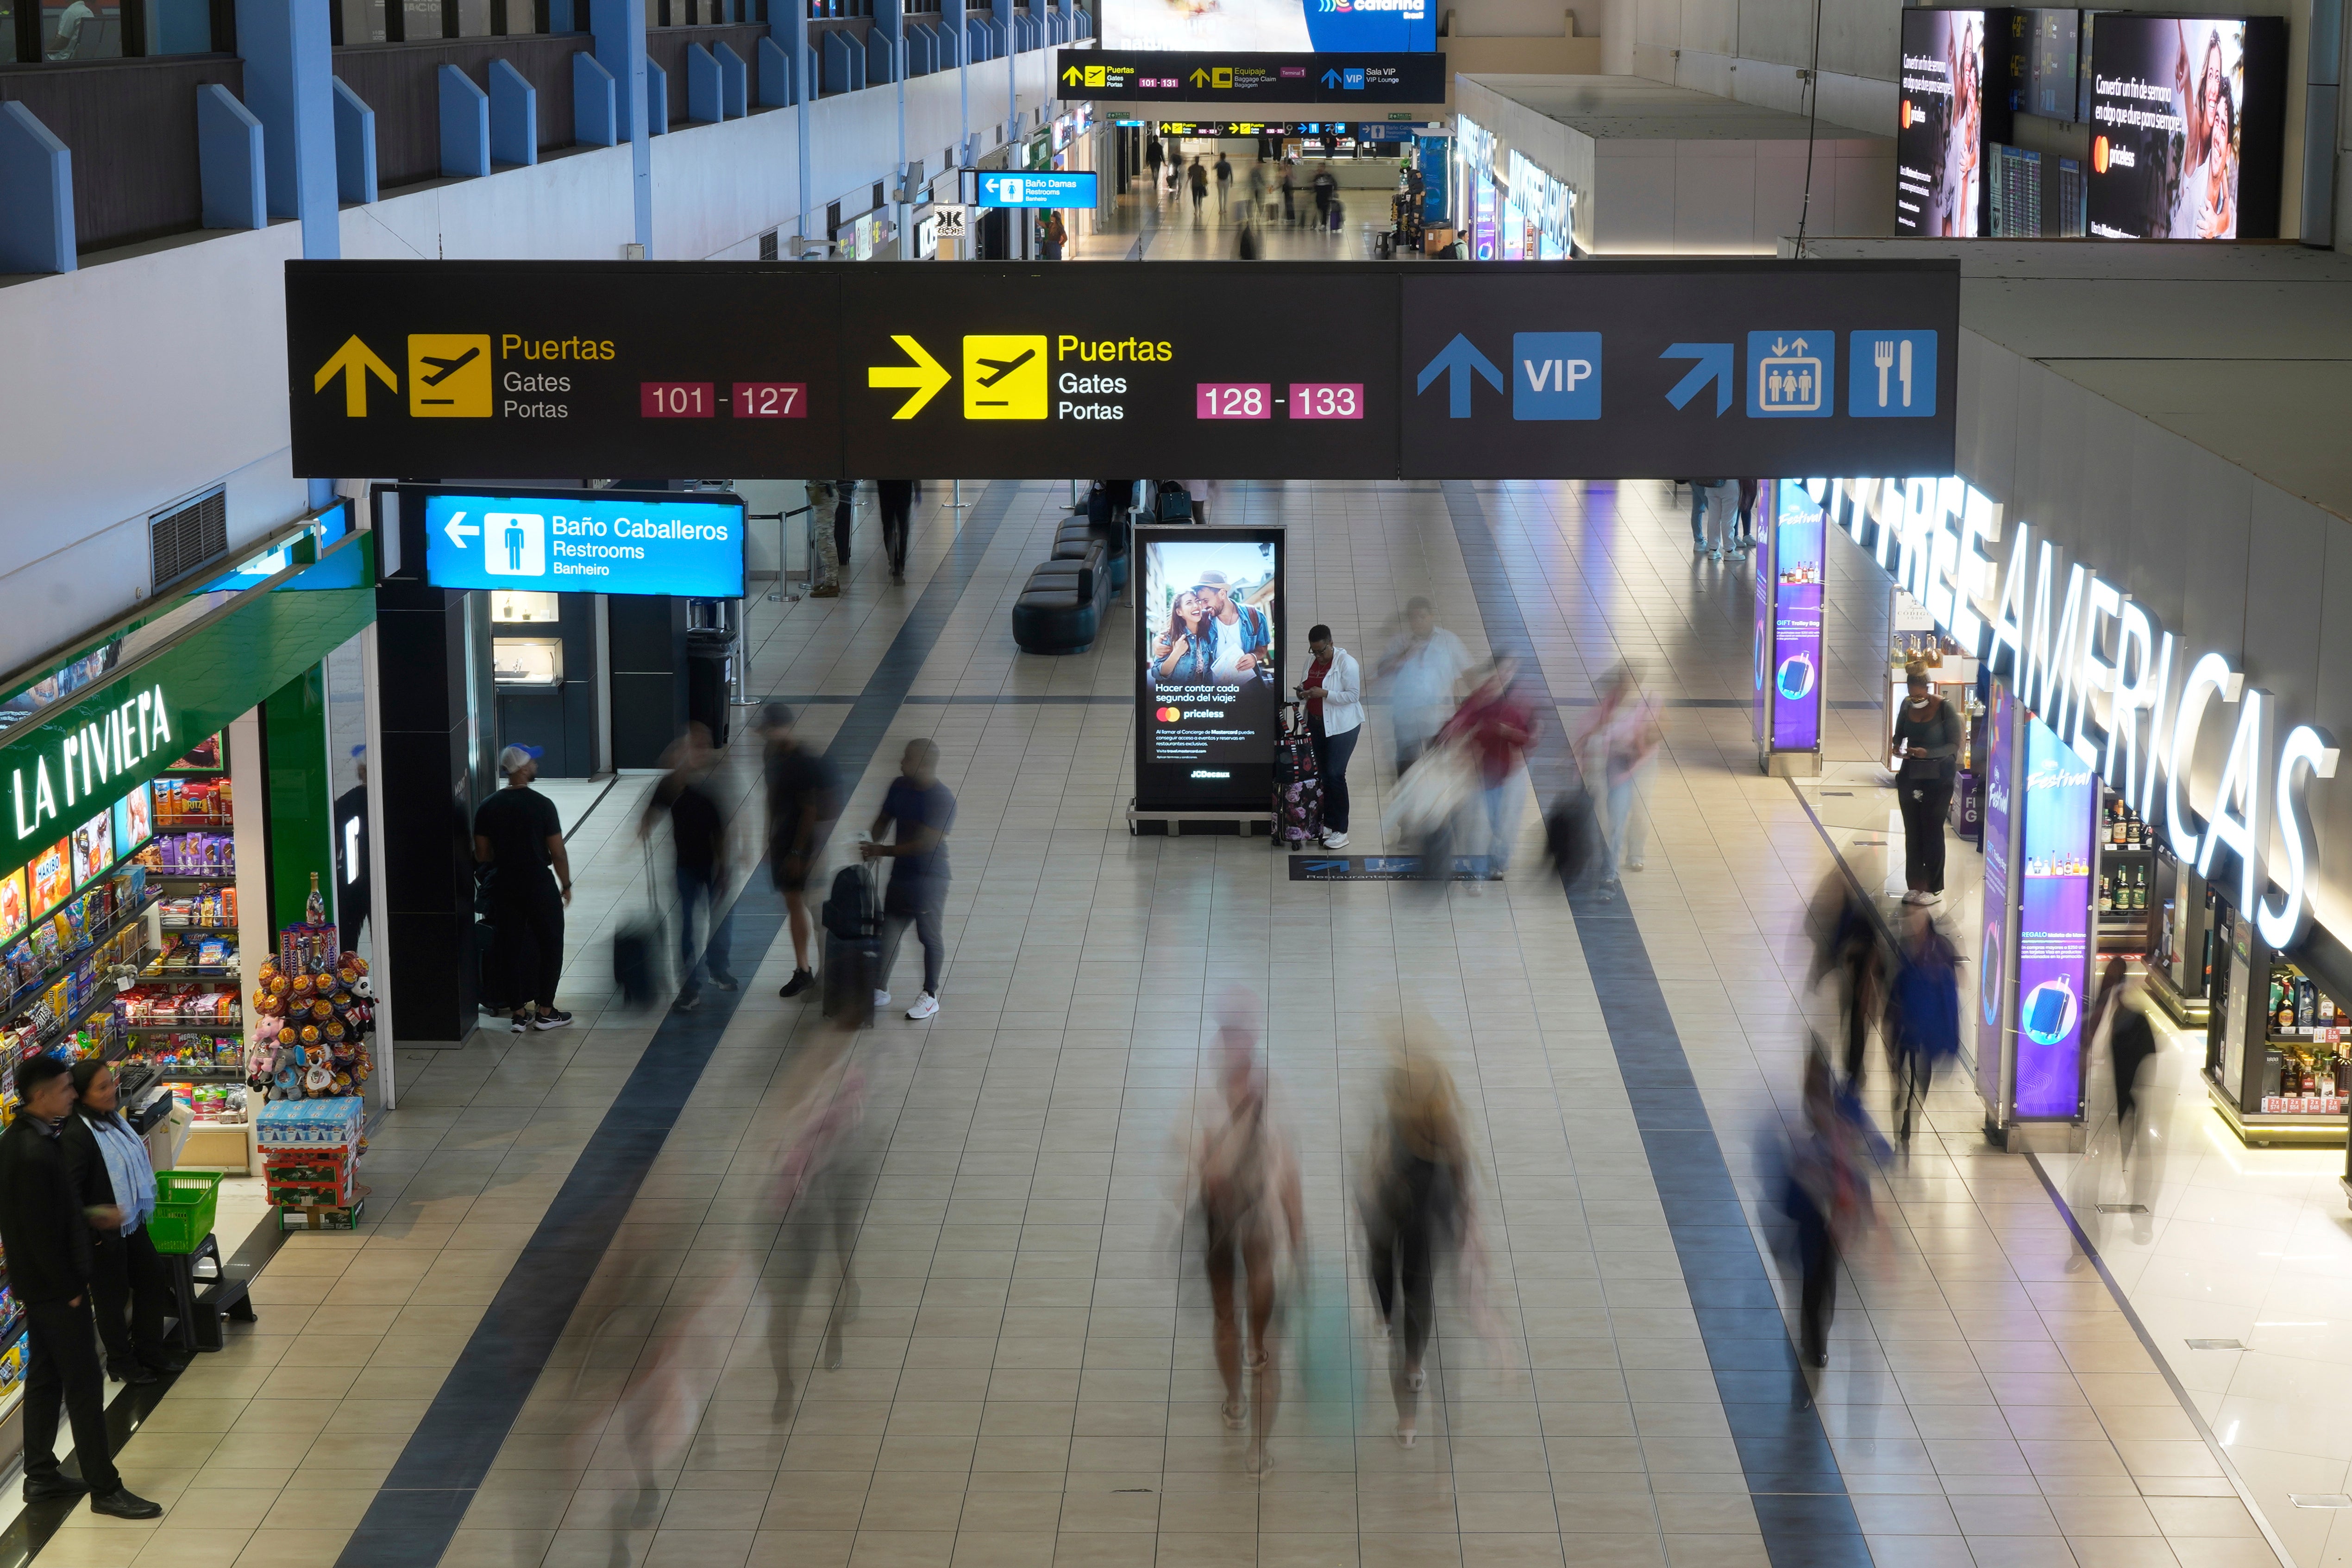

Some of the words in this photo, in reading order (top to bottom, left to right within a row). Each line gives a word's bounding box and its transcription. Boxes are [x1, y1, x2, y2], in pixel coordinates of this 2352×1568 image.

[1235, 68, 1266, 76] Equipaje
[2096, 74, 2123, 96] Convertir
[2123, 82, 2130, 97] un
[2139, 79, 2147, 100] de
[2148, 85, 2171, 102] semana
[2095, 106, 2102, 119] en
[2103, 101, 2115, 126] algo
[2116, 108, 2126, 127] que
[2127, 104, 2141, 125] dure
[2141, 112, 2155, 131] para
[2156, 109, 2182, 136] siempre:
[2109, 144, 2135, 168] priceless
[1025, 179, 1046, 188] Baño
[502, 334, 615, 361] Puertas
[1058, 335, 1172, 361] Puertas
[504, 372, 571, 393] Gates
[1059, 373, 1127, 394] Gates
[1524, 359, 1592, 391] VIP
[504, 400, 568, 419] Portas
[652, 388, 703, 414] 101
[742, 388, 798, 414] 127
[1059, 401, 1124, 420] Portas
[1205, 389, 1262, 416] 128
[1298, 389, 1355, 416] 133
[552, 515, 607, 537] Baño
[614, 518, 728, 541] Caballeros
[1778, 508, 1824, 527] Festival
[553, 541, 645, 559] Restrooms
[553, 562, 609, 576] Banheiro
[1156, 694, 1195, 703] segundo
[1212, 694, 1236, 703] viaje:
[1217, 684, 1239, 692] cada
[1184, 709, 1224, 720] priceless
[1876, 476, 1994, 658] FREE
[1988, 521, 2327, 949] AMERICAS
[2026, 769, 2093, 792] Festival
[13, 754, 56, 840] LA
[187, 801, 203, 809] RITZ
[1988, 783, 2009, 815] Festival
[37, 855, 59, 881] HARIBO
[4, 1079, 13, 1094] $25
